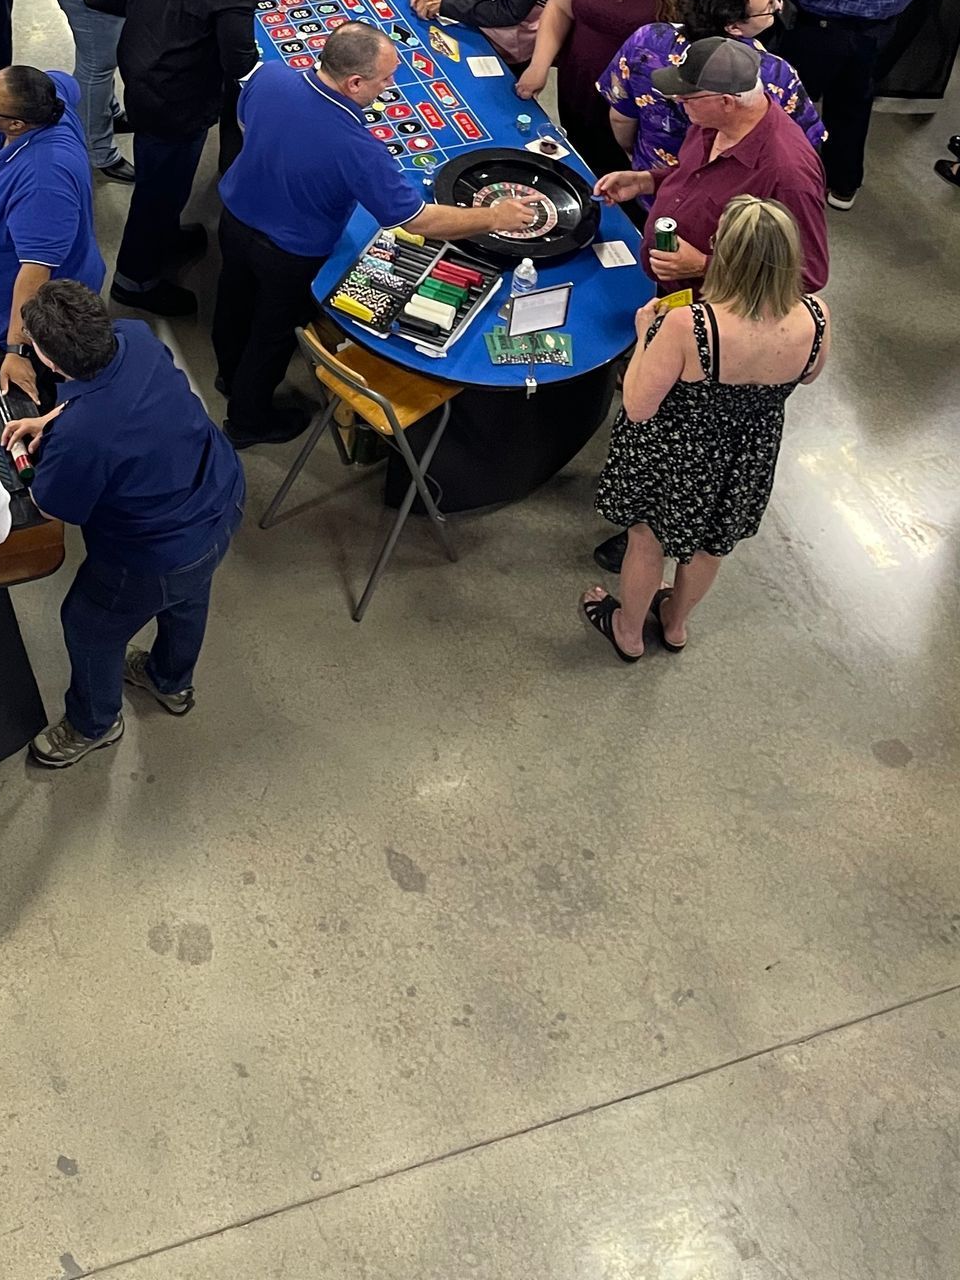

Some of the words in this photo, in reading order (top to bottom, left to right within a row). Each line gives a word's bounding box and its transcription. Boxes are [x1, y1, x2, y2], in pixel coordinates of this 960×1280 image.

[266, 15, 281, 23] 30
[276, 29, 291, 37] 27
[285, 43, 300, 51] 24
[293, 58, 309, 66] 21
[395, 108, 404, 116] 7
[365, 114, 375, 122] 8
[405, 124, 415, 132] 4
